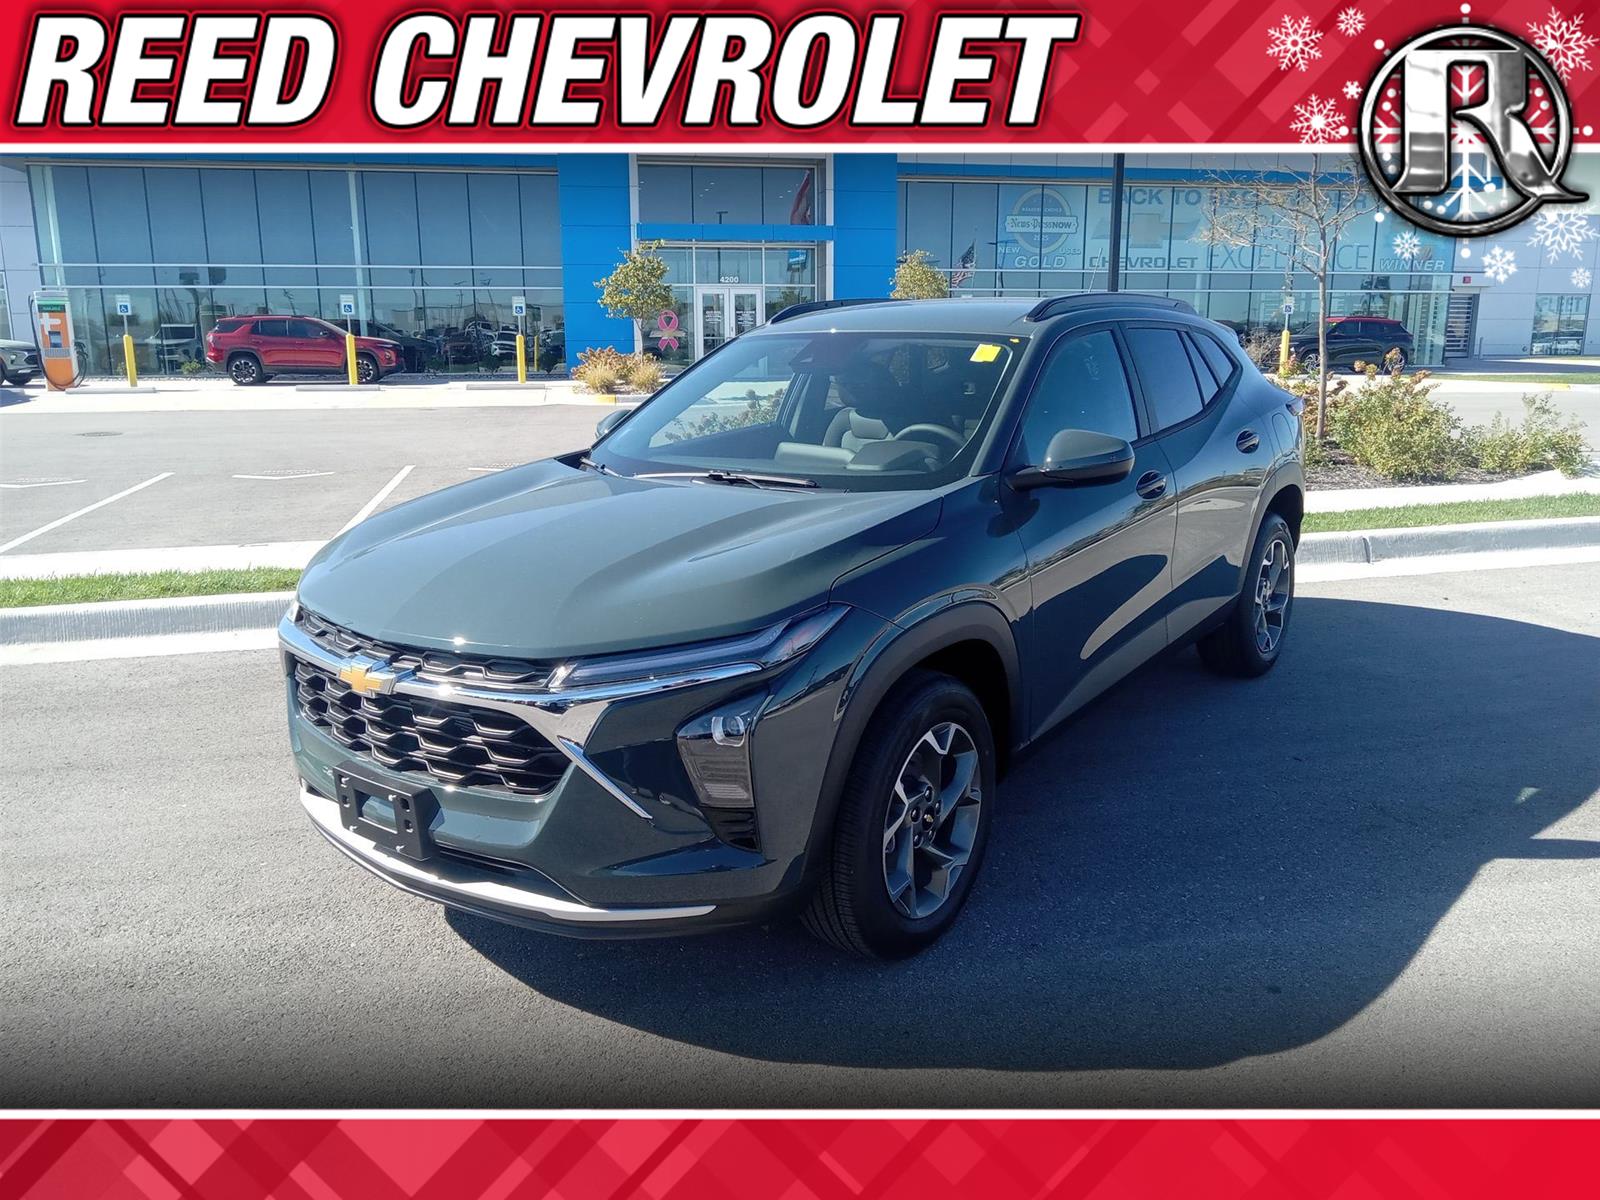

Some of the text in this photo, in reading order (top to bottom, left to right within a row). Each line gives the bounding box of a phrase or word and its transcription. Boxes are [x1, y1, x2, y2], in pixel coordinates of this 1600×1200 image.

[1173, 189, 1202, 205] TO
[1014, 255, 1067, 269] GOLD
[1380, 259, 1446, 272] WINNER
